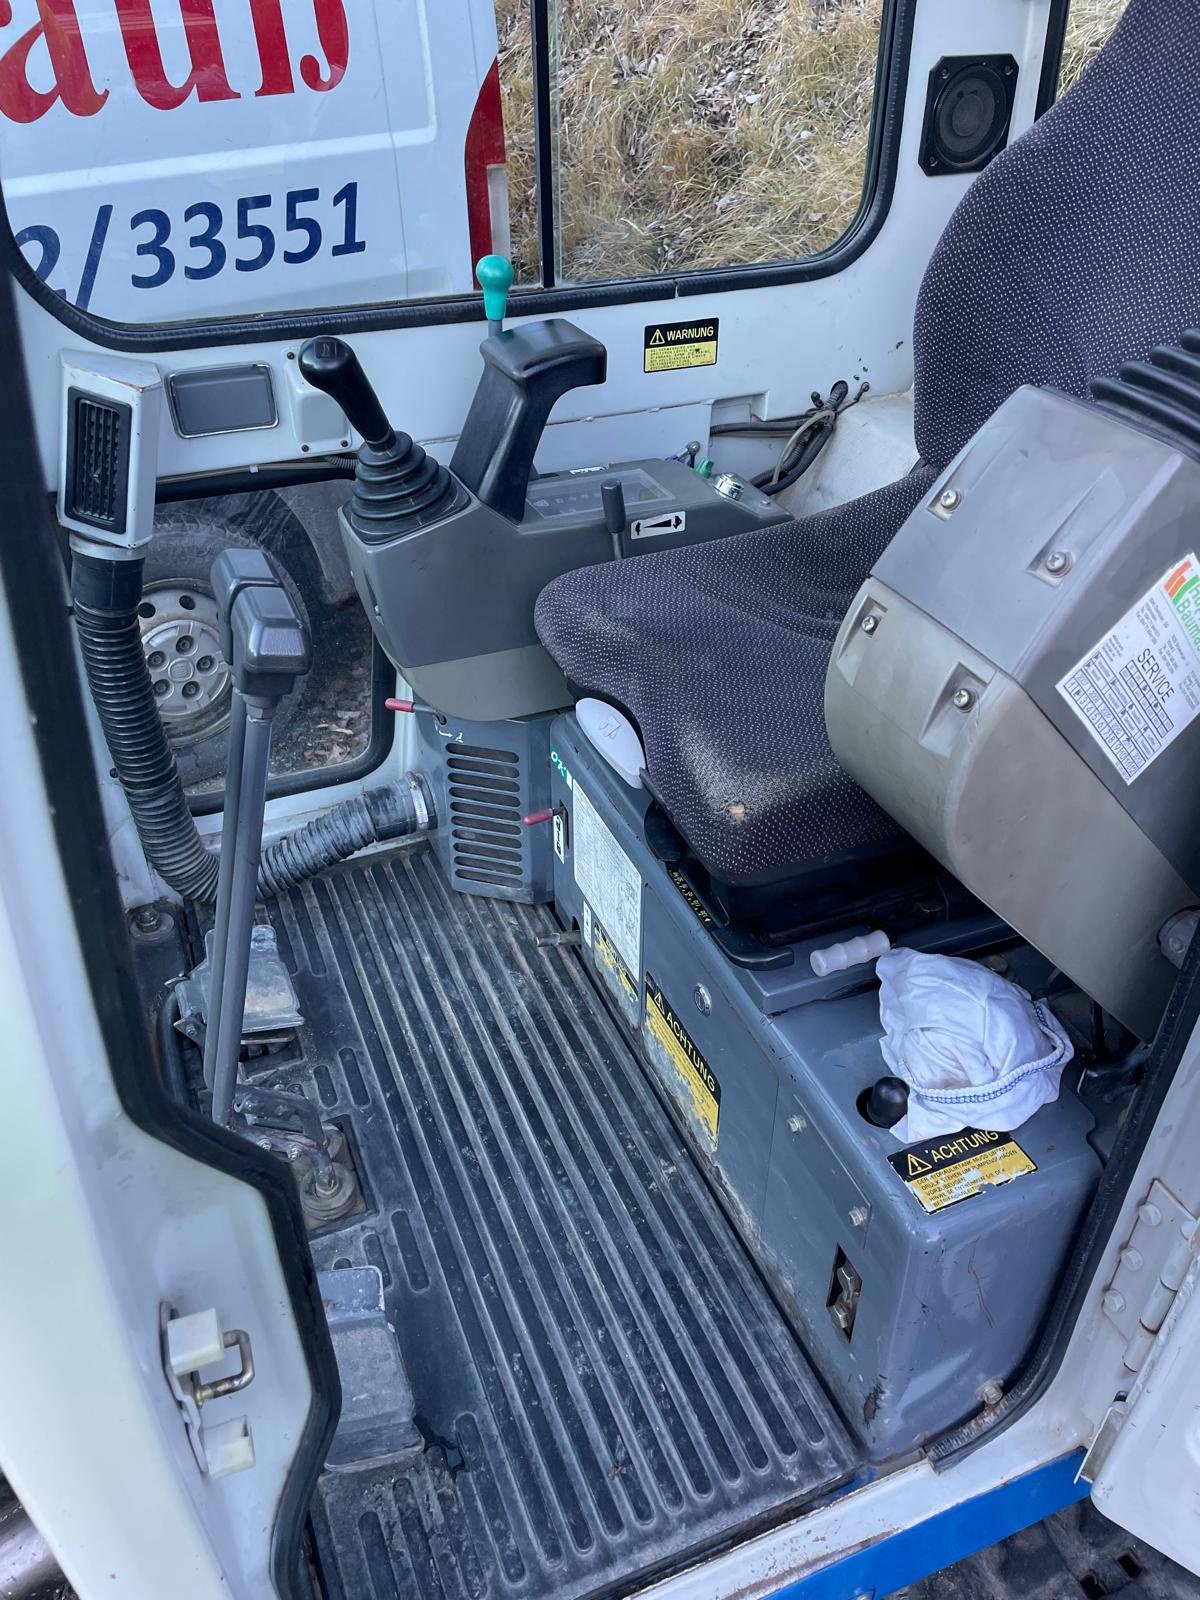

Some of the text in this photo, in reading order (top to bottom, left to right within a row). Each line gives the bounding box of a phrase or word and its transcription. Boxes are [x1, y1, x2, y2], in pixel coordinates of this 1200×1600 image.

[667, 326, 714, 341] WARNUNG
[1137, 648, 1175, 703] SERVICE
[667, 1011, 715, 1093] ACHTUNG
[930, 1131, 999, 1163] ACHTUNG
